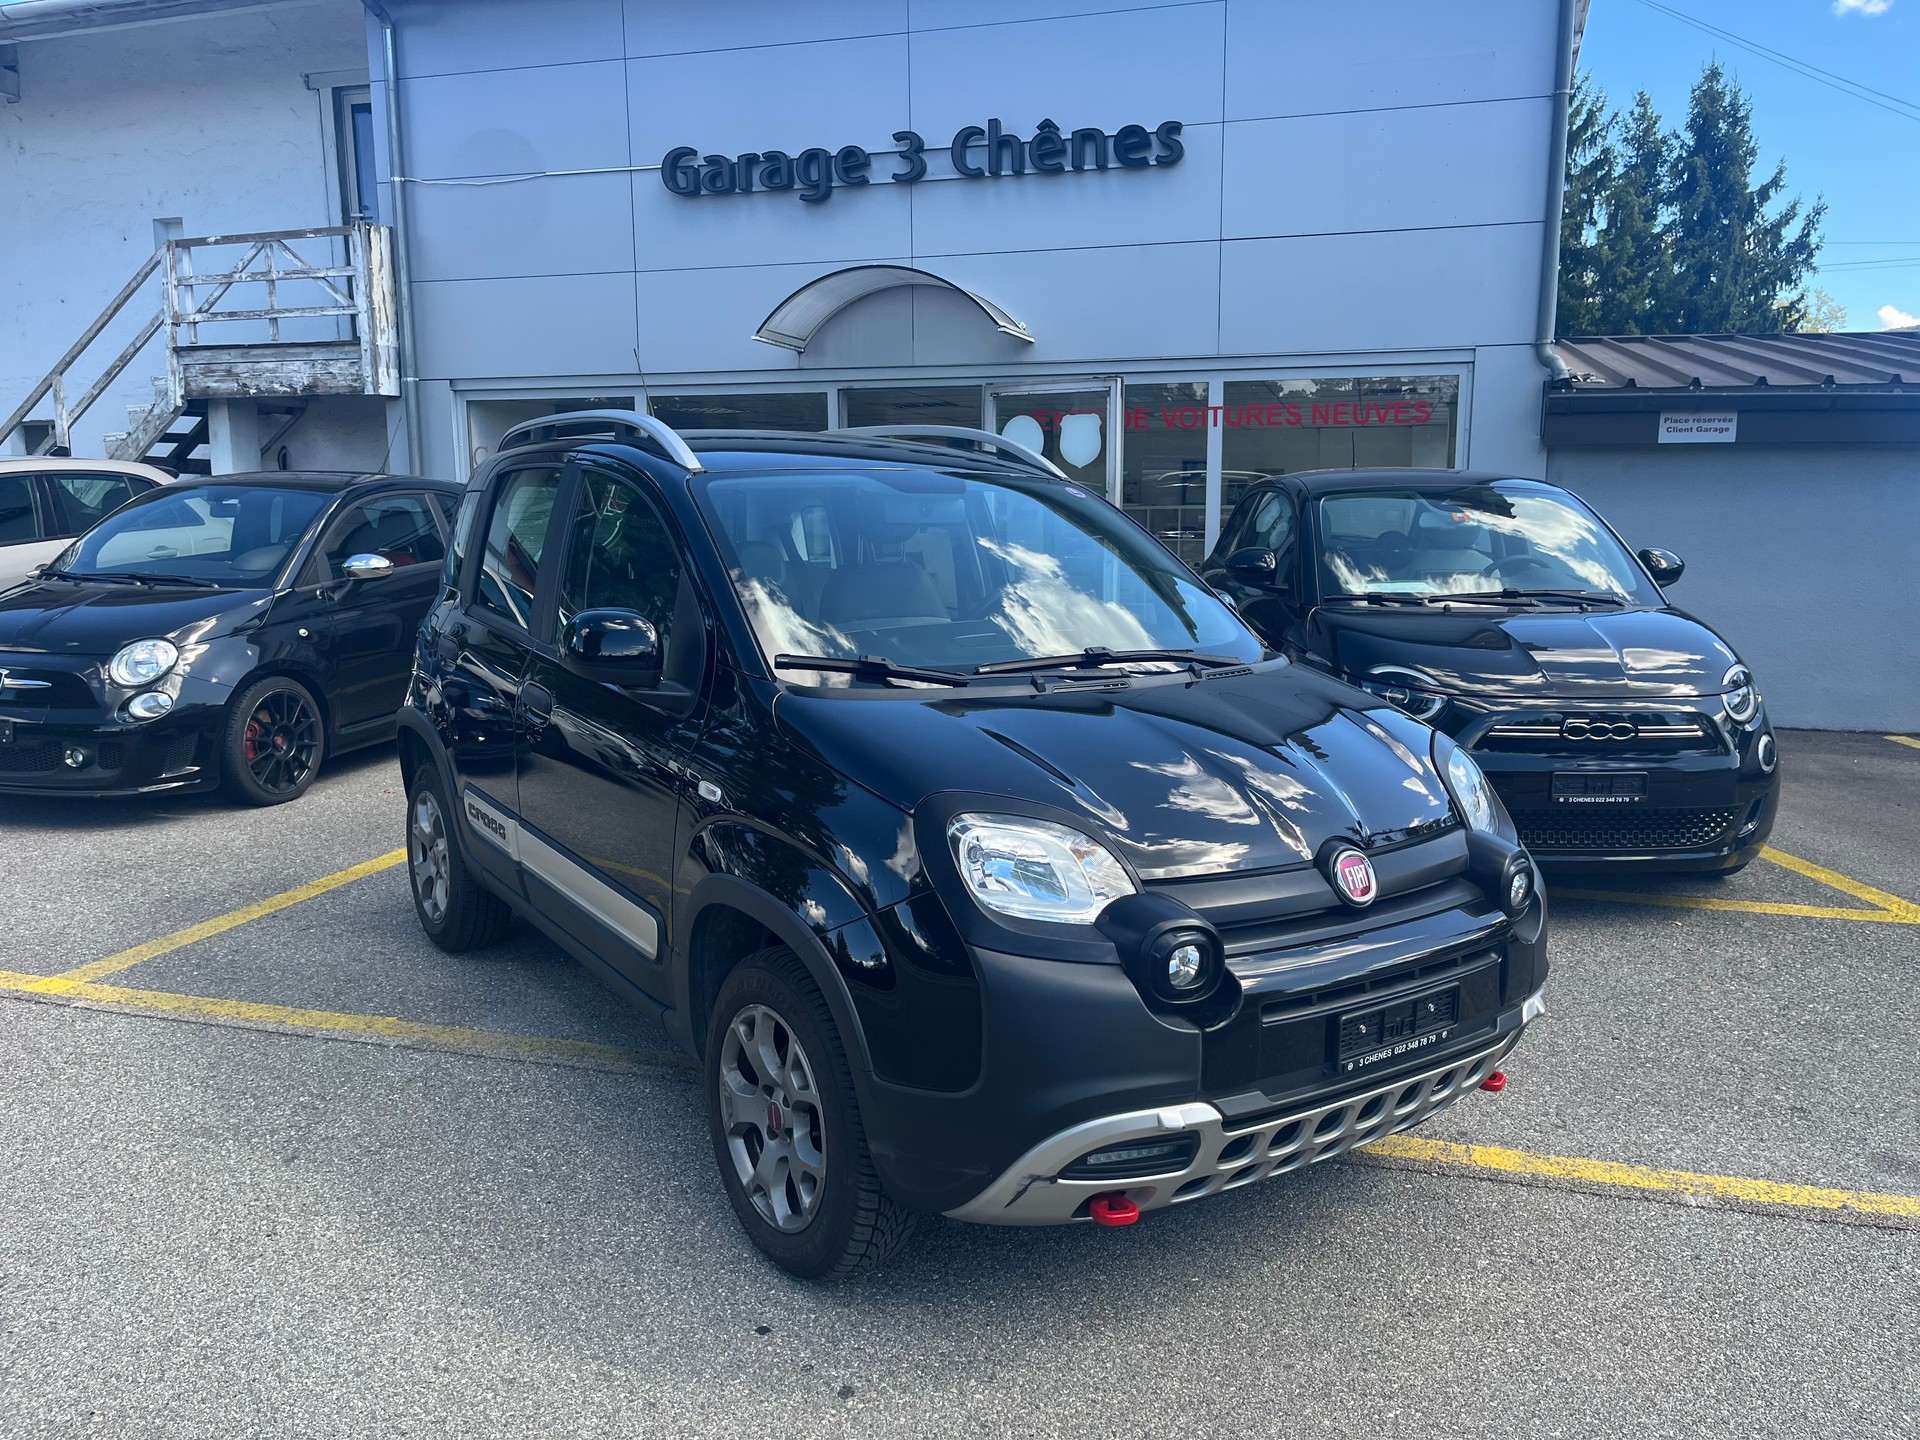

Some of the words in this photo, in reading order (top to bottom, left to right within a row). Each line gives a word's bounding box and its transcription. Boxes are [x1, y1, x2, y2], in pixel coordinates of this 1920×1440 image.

[660, 145, 872, 202] Garage
[892, 130, 928, 184] 3
[951, 118, 1186, 177] Chênes
[1161, 403, 1302, 430] VOITURES
[1311, 400, 1433, 426] NEUVES
[1692, 416, 1734, 424] réservée
[1696, 426, 1730, 434] Garage
[1563, 719, 1636, 740] 500
[1343, 864, 1369, 890] FIAT
[1359, 1058, 1364, 1067] 3
[1364, 1048, 1392, 1065] CHENES
[1394, 1044, 1406, 1055] 022
[1406, 1040, 1419, 1050] 348
[1420, 1038, 1428, 1046] 78
[1428, 1034, 1436, 1043] 79
